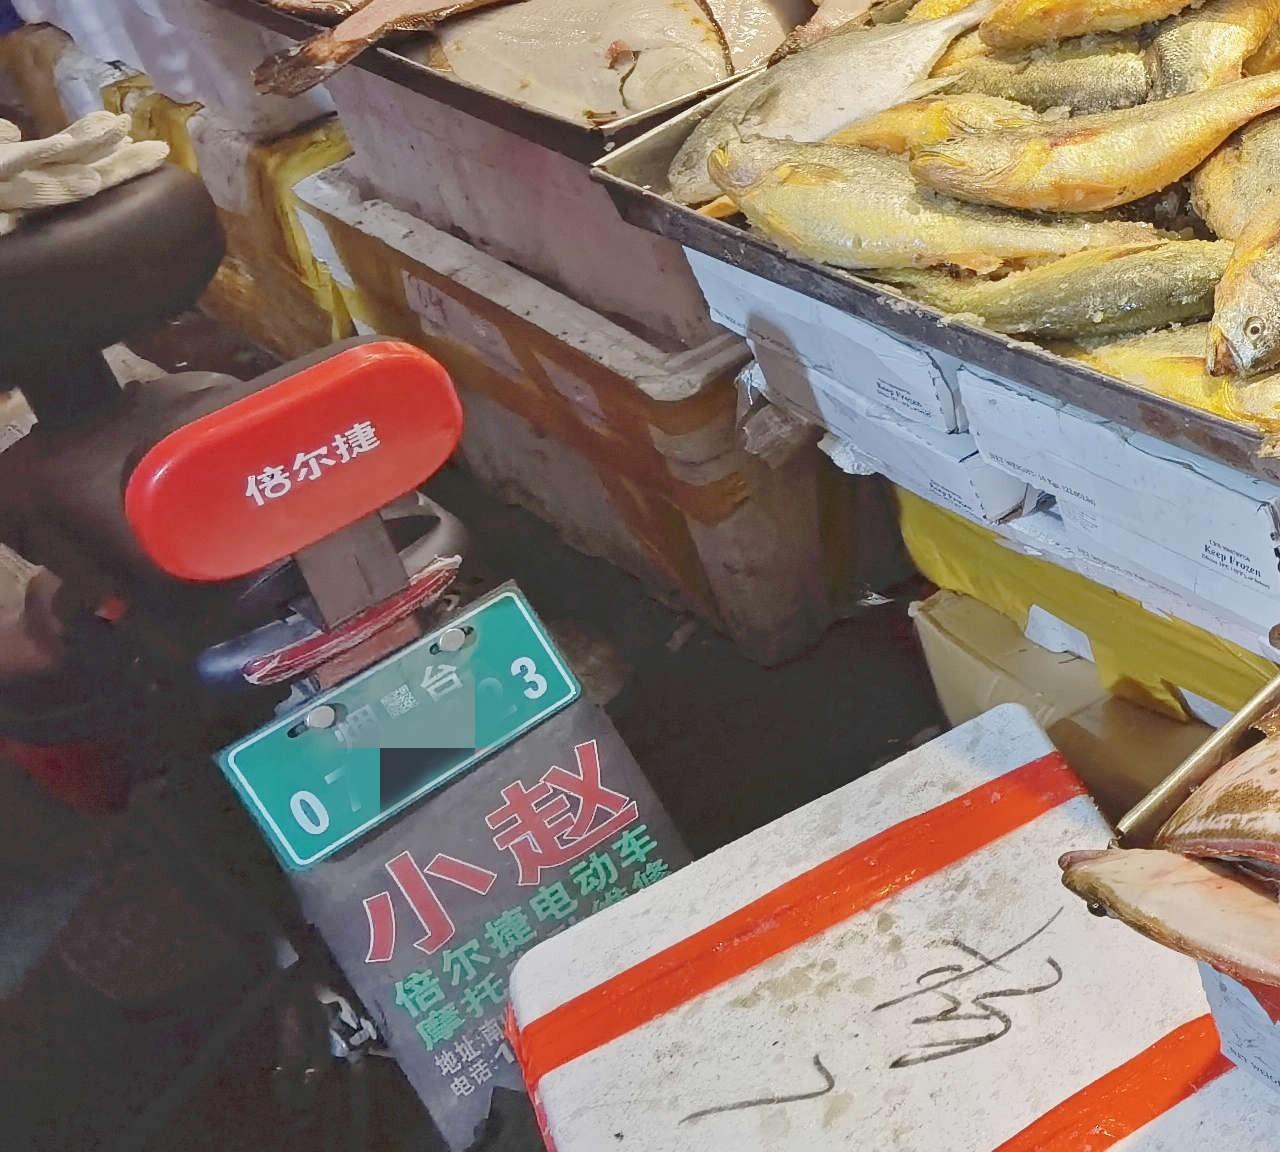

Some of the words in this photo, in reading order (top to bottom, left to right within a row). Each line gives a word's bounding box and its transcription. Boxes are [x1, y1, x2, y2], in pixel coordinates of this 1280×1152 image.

[243, 419, 382, 508] 倍尔捷
[1204, 544, 1227, 563] Keep
[1229, 555, 1262, 577] Frozen
[363, 739, 638, 963] 小赵
[394, 824, 658, 1019] 倍尔捷电动车
